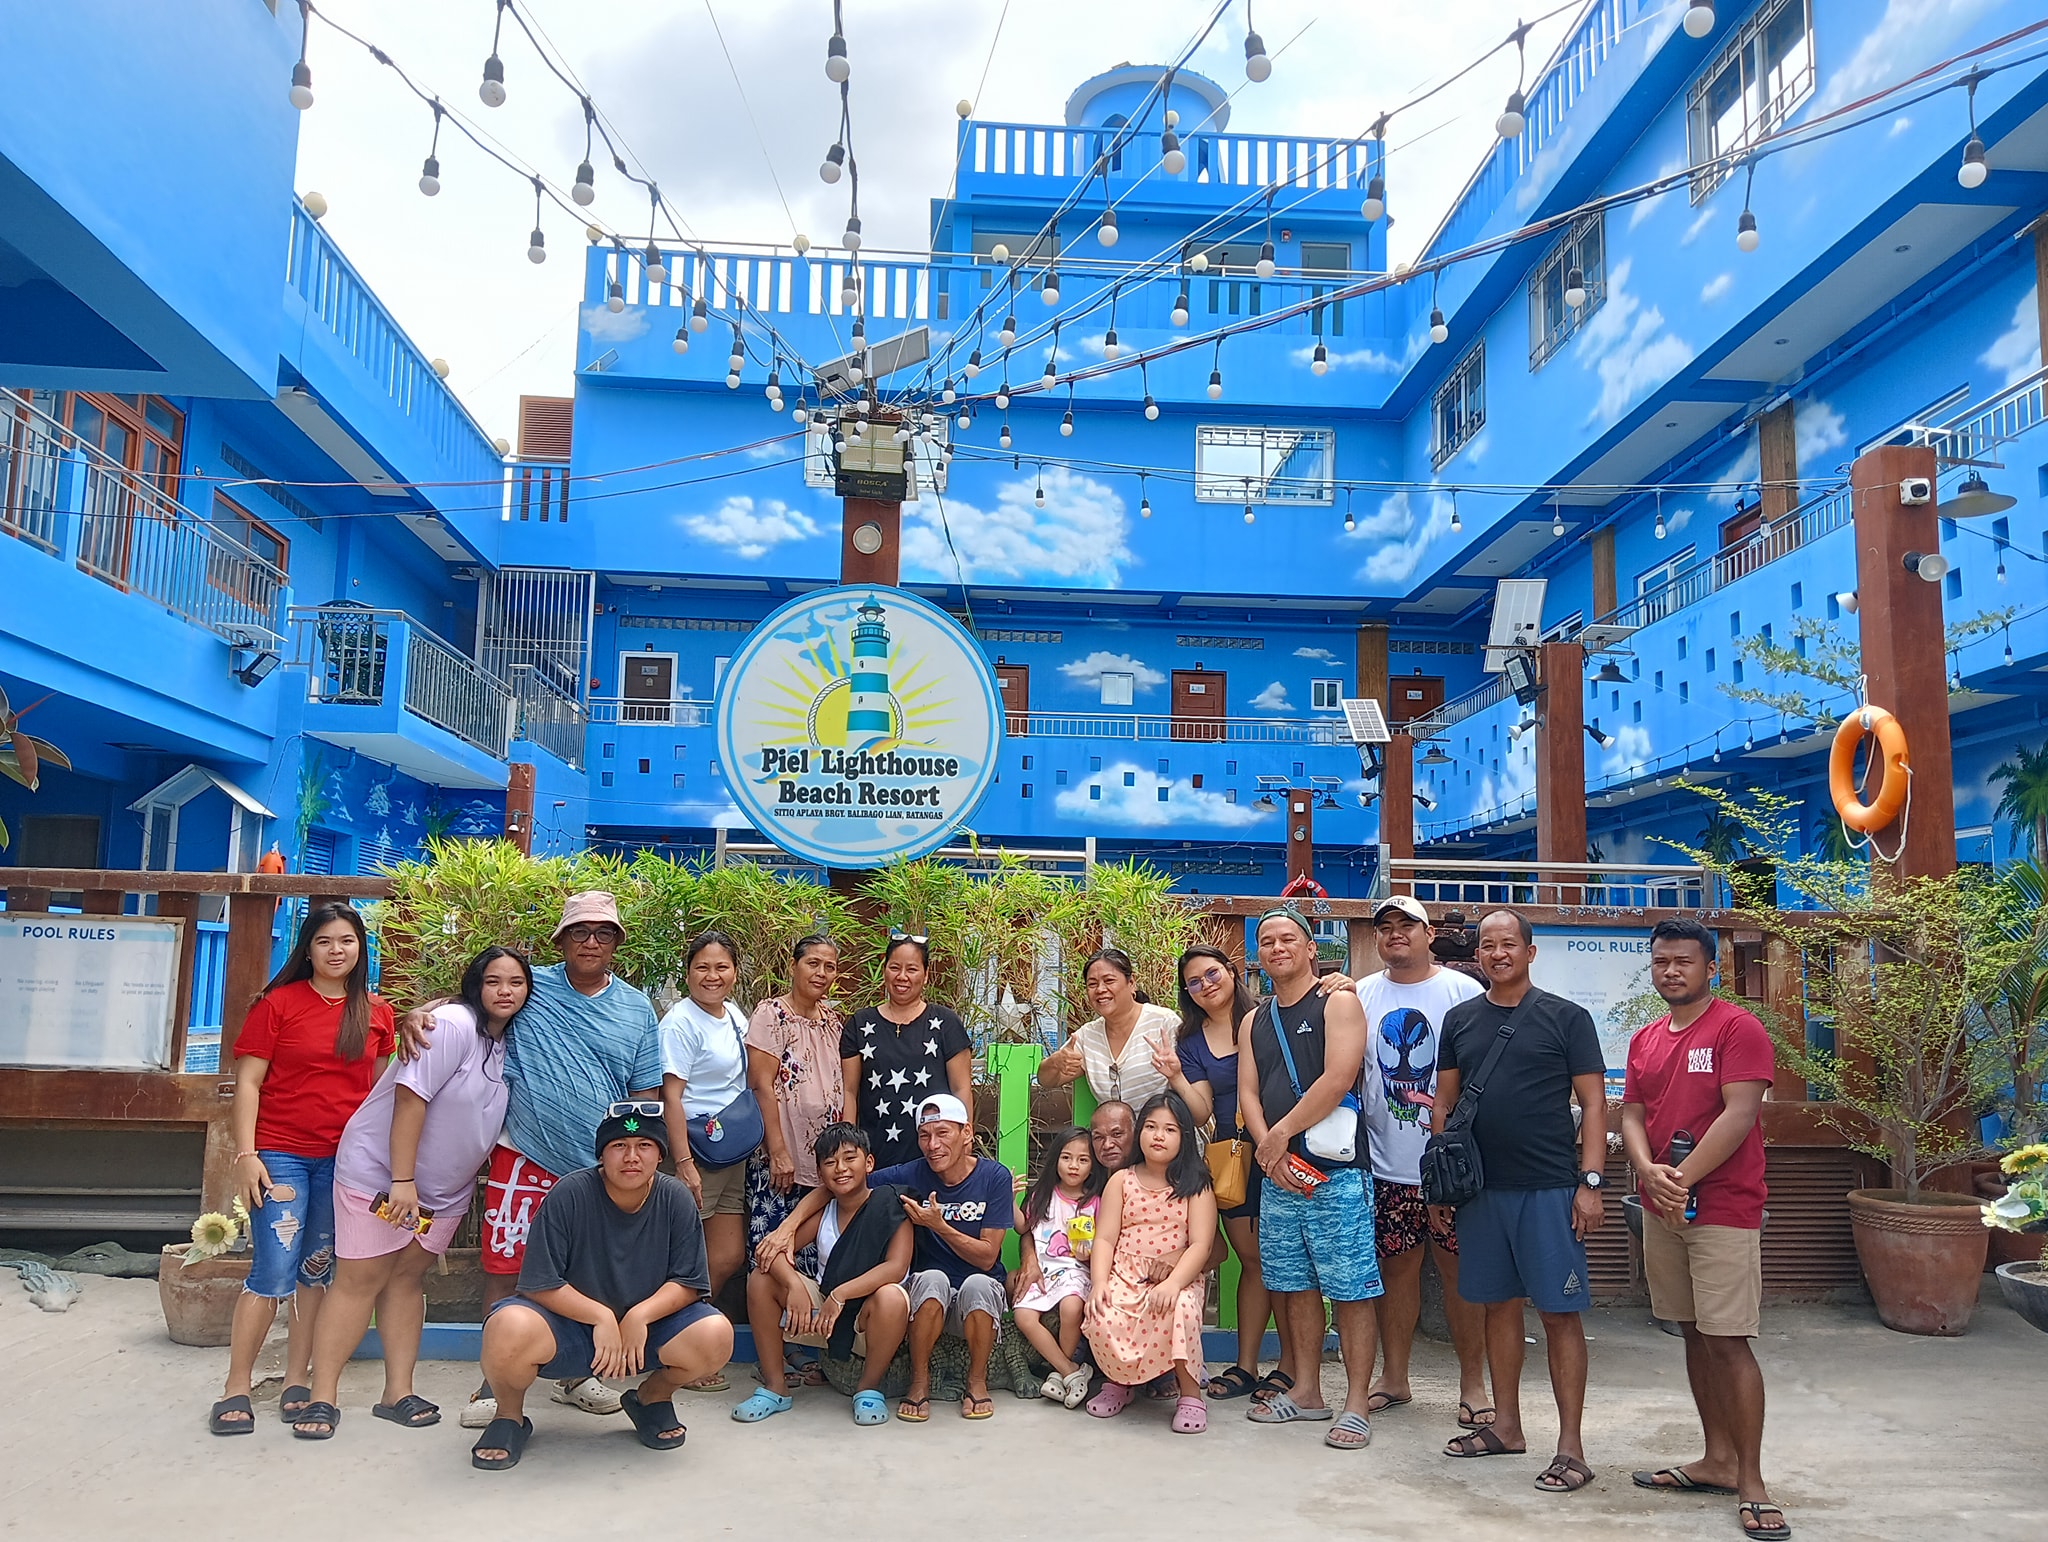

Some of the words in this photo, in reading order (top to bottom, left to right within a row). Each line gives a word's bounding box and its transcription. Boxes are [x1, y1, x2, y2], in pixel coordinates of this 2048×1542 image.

[762, 748, 809, 773] Piel
[821, 749, 959, 780] Lighthouse
[778, 780, 852, 804] Beach
[858, 782, 940, 806] Resort
[796, 809, 823, 818] APLAYA
[824, 809, 846, 818] BRGY.
[847, 809, 884, 819] BALIBAGO
[885, 810, 904, 820] LIAN,
[905, 811, 943, 820] BATANGAS
[22, 926, 63, 939] POOL
[68, 927, 116, 941] RULES
[1567, 941, 1604, 952] POOL
[1609, 940, 1652, 953] RULES
[1688, 1047, 1713, 1056] MAKE
[1688, 1054, 1712, 1064] YOUR
[1688, 1062, 1713, 1072] MOVE
